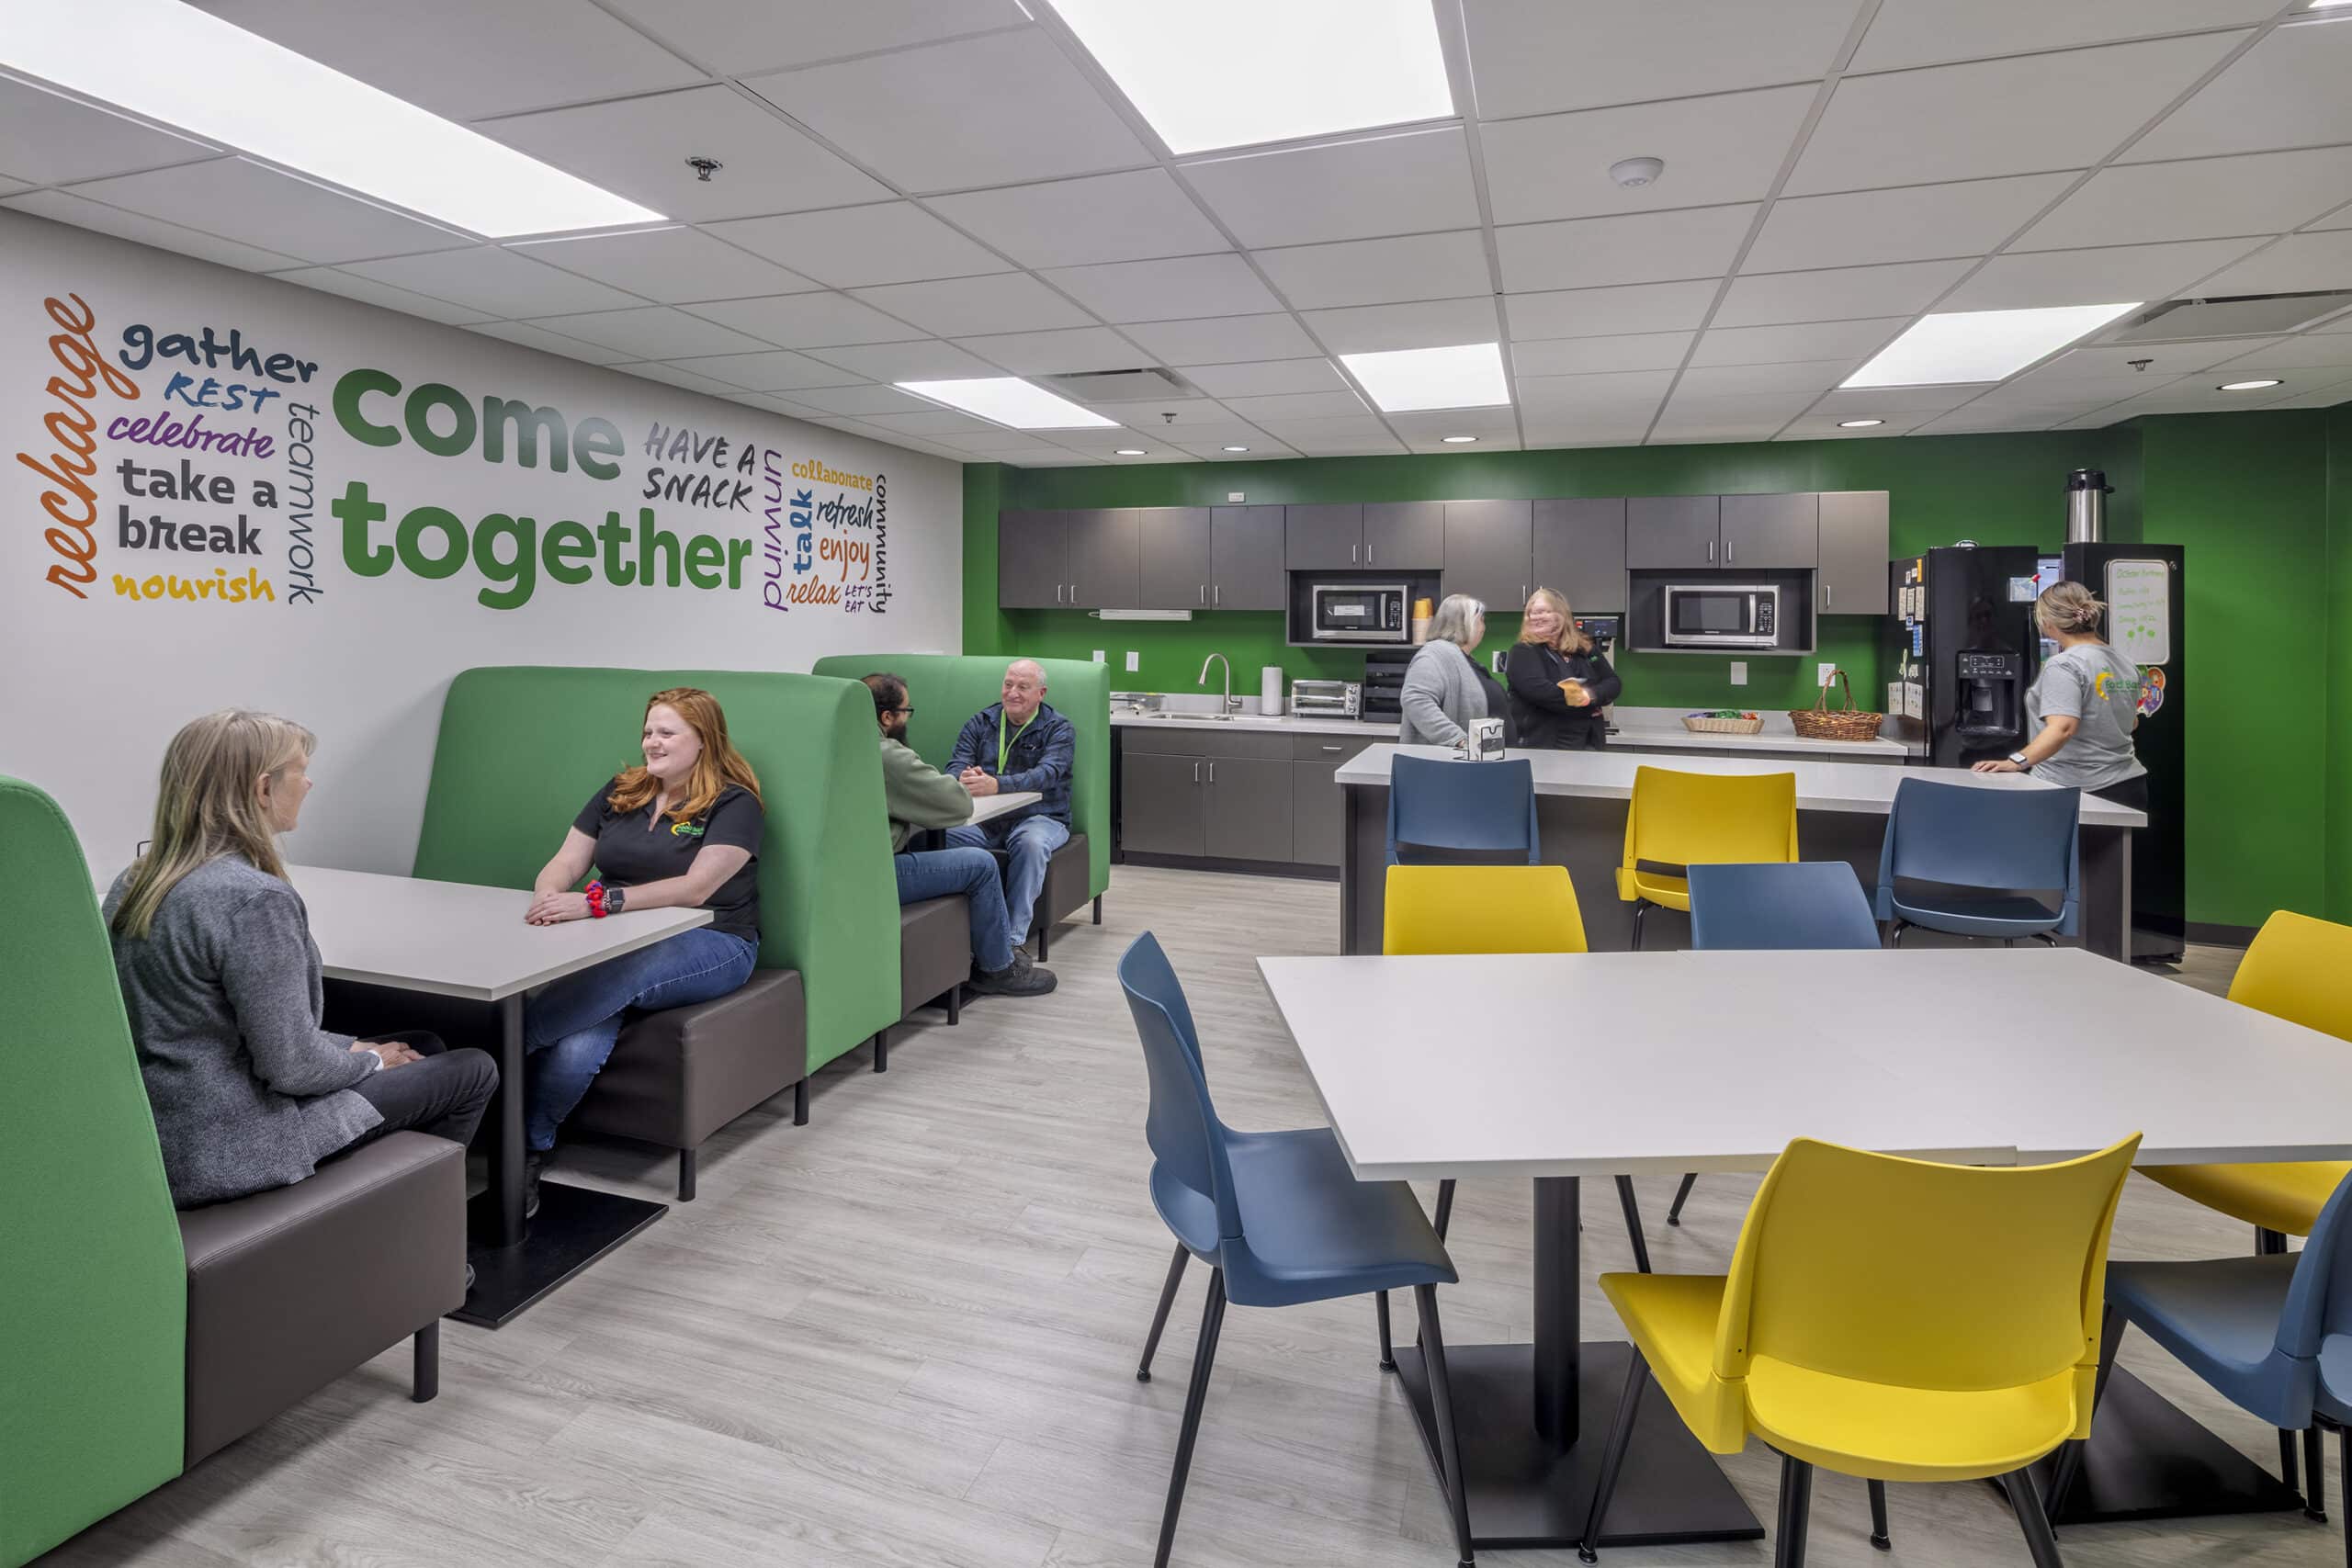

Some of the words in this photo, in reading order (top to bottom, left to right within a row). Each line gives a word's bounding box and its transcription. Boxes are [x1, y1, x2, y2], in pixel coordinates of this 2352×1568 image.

[119, 324, 319, 383] gather
[164, 371, 280, 413] REST
[16, 292, 141, 599] recharge
[107, 411, 275, 458] celebrate
[333, 368, 625, 480] come
[644, 422, 729, 468] HAVE
[737, 444, 755, 476] A
[117, 458, 235, 504] take
[253, 478, 278, 508] a
[643, 468, 753, 513] SNACK
[792, 459, 873, 491] collaborate
[288, 402, 324, 604] teamwork
[816, 493, 873, 530] refresh
[119, 504, 263, 555] break
[332, 480, 752, 610] together
[763, 449, 788, 612] unwind
[790, 488, 812, 575] talk
[868, 474, 893, 614] community
[820, 529, 870, 582] enjoy
[112, 568, 276, 603] nourish
[786, 574, 841, 605] relax
[844, 584, 872, 598] LET'S
[844, 600, 865, 614] EAT
